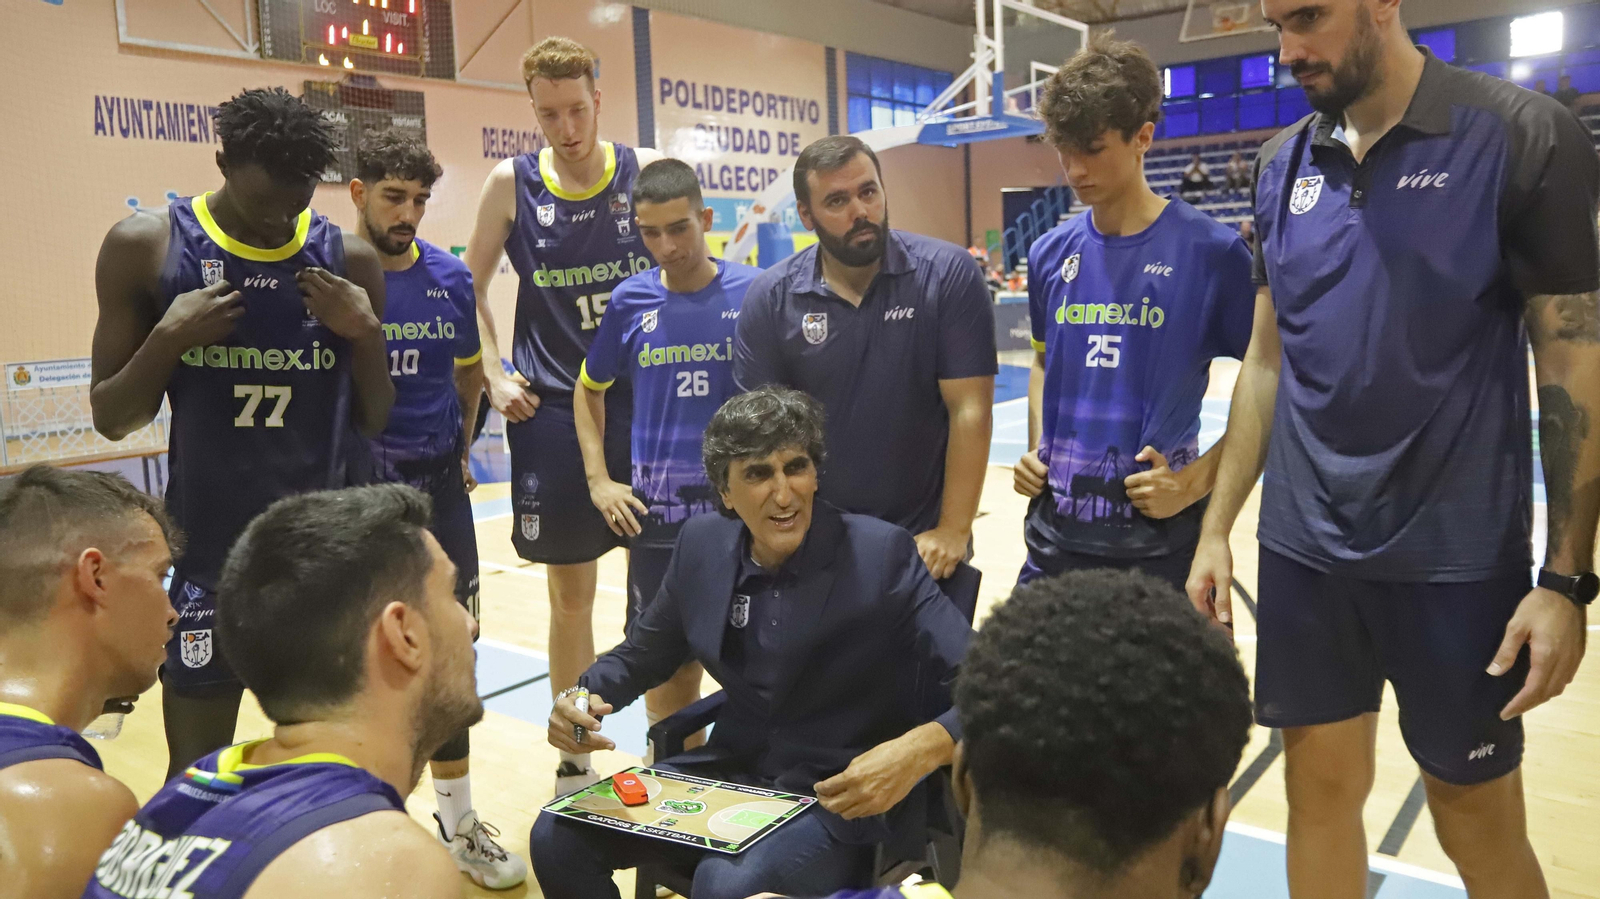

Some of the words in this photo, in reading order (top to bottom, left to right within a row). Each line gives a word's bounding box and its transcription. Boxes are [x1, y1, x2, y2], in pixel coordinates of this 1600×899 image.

[659, 77, 820, 125] POLIDEPORTIVO
[777, 131, 800, 156] DE
[696, 162, 786, 192] ALGECIR
[533, 252, 651, 287] damex.io
[576, 292, 612, 330] 15
[1055, 295, 1165, 328] damex.io
[390, 349, 420, 376] 10
[1086, 335, 1122, 368] 25
[676, 370, 710, 397] 26
[234, 385, 292, 427] 77
[587, 814, 632, 829] GATORS
